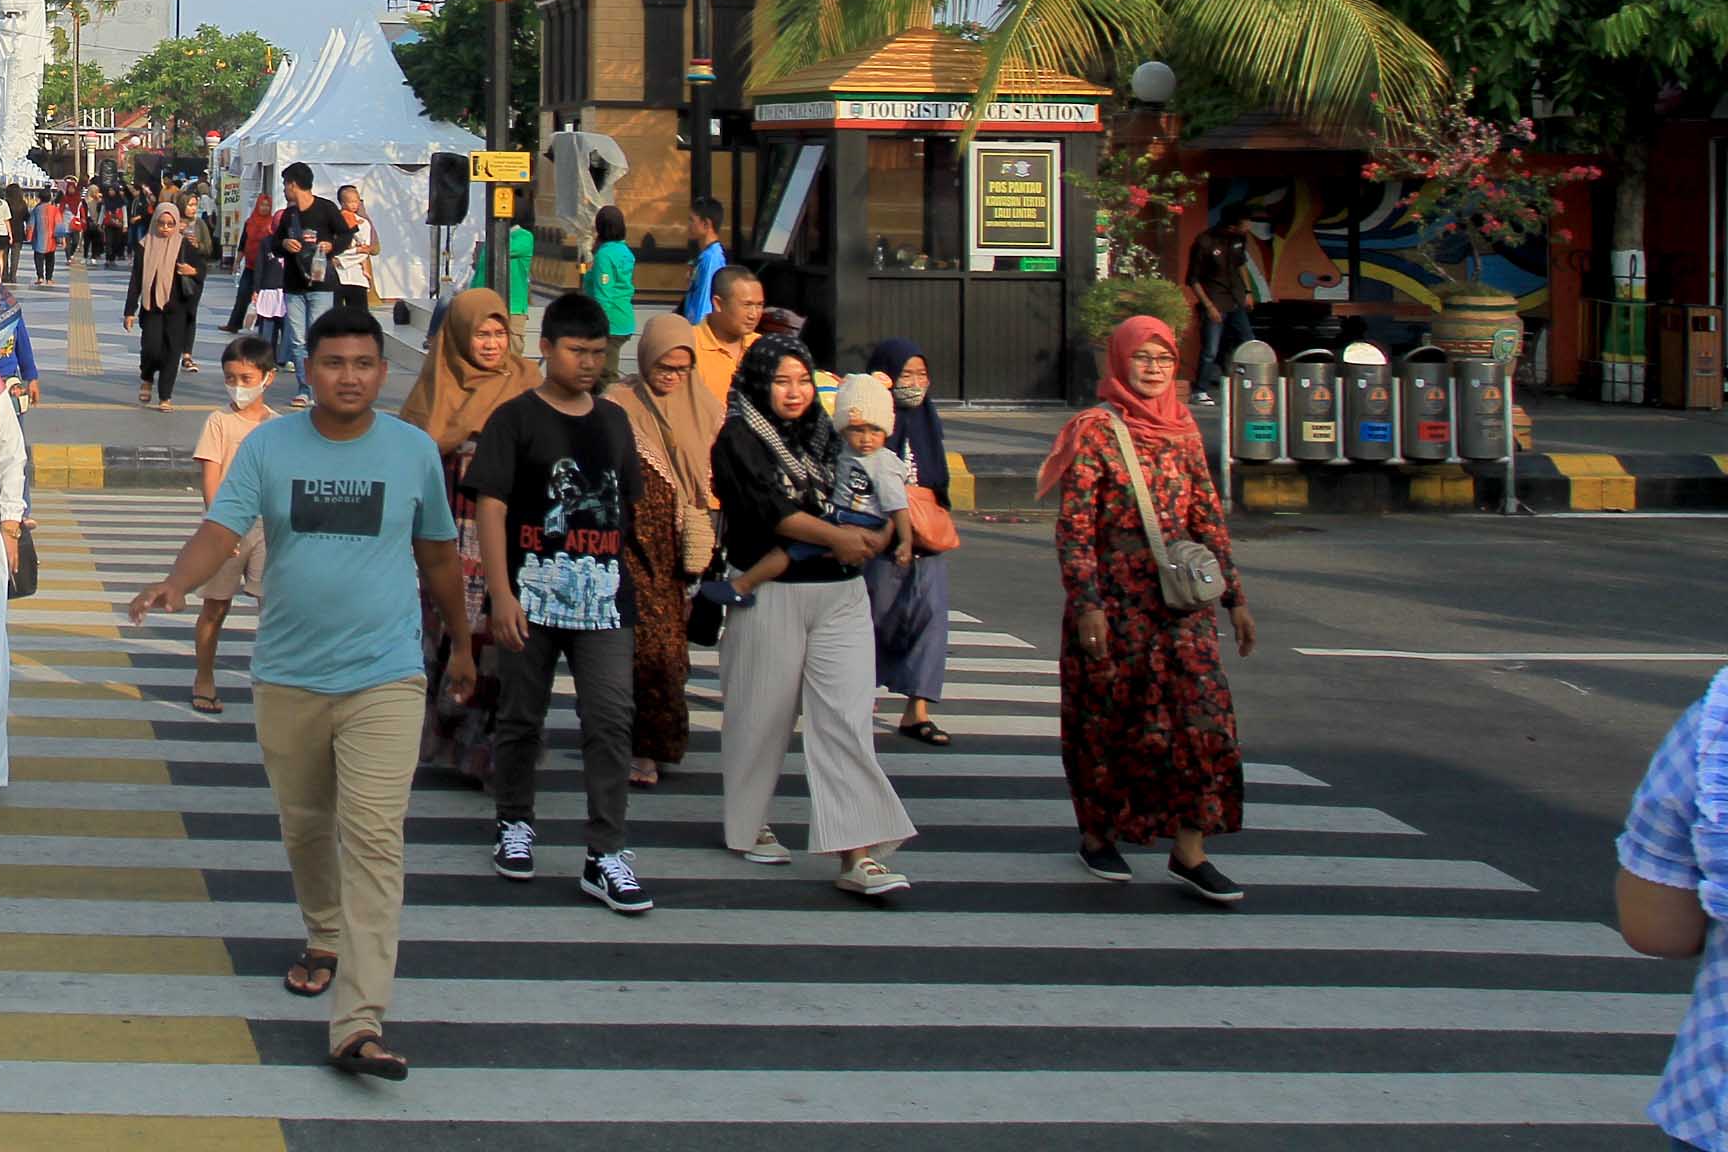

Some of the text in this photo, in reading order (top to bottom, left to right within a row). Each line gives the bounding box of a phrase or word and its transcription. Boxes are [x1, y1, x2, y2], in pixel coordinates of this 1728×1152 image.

[868, 102, 942, 118] TOURIST
[1014, 105, 1085, 120] STATION
[989, 181, 1042, 193] POS PANTAU
[304, 478, 372, 496] DENIM
[520, 525, 543, 551] BE
